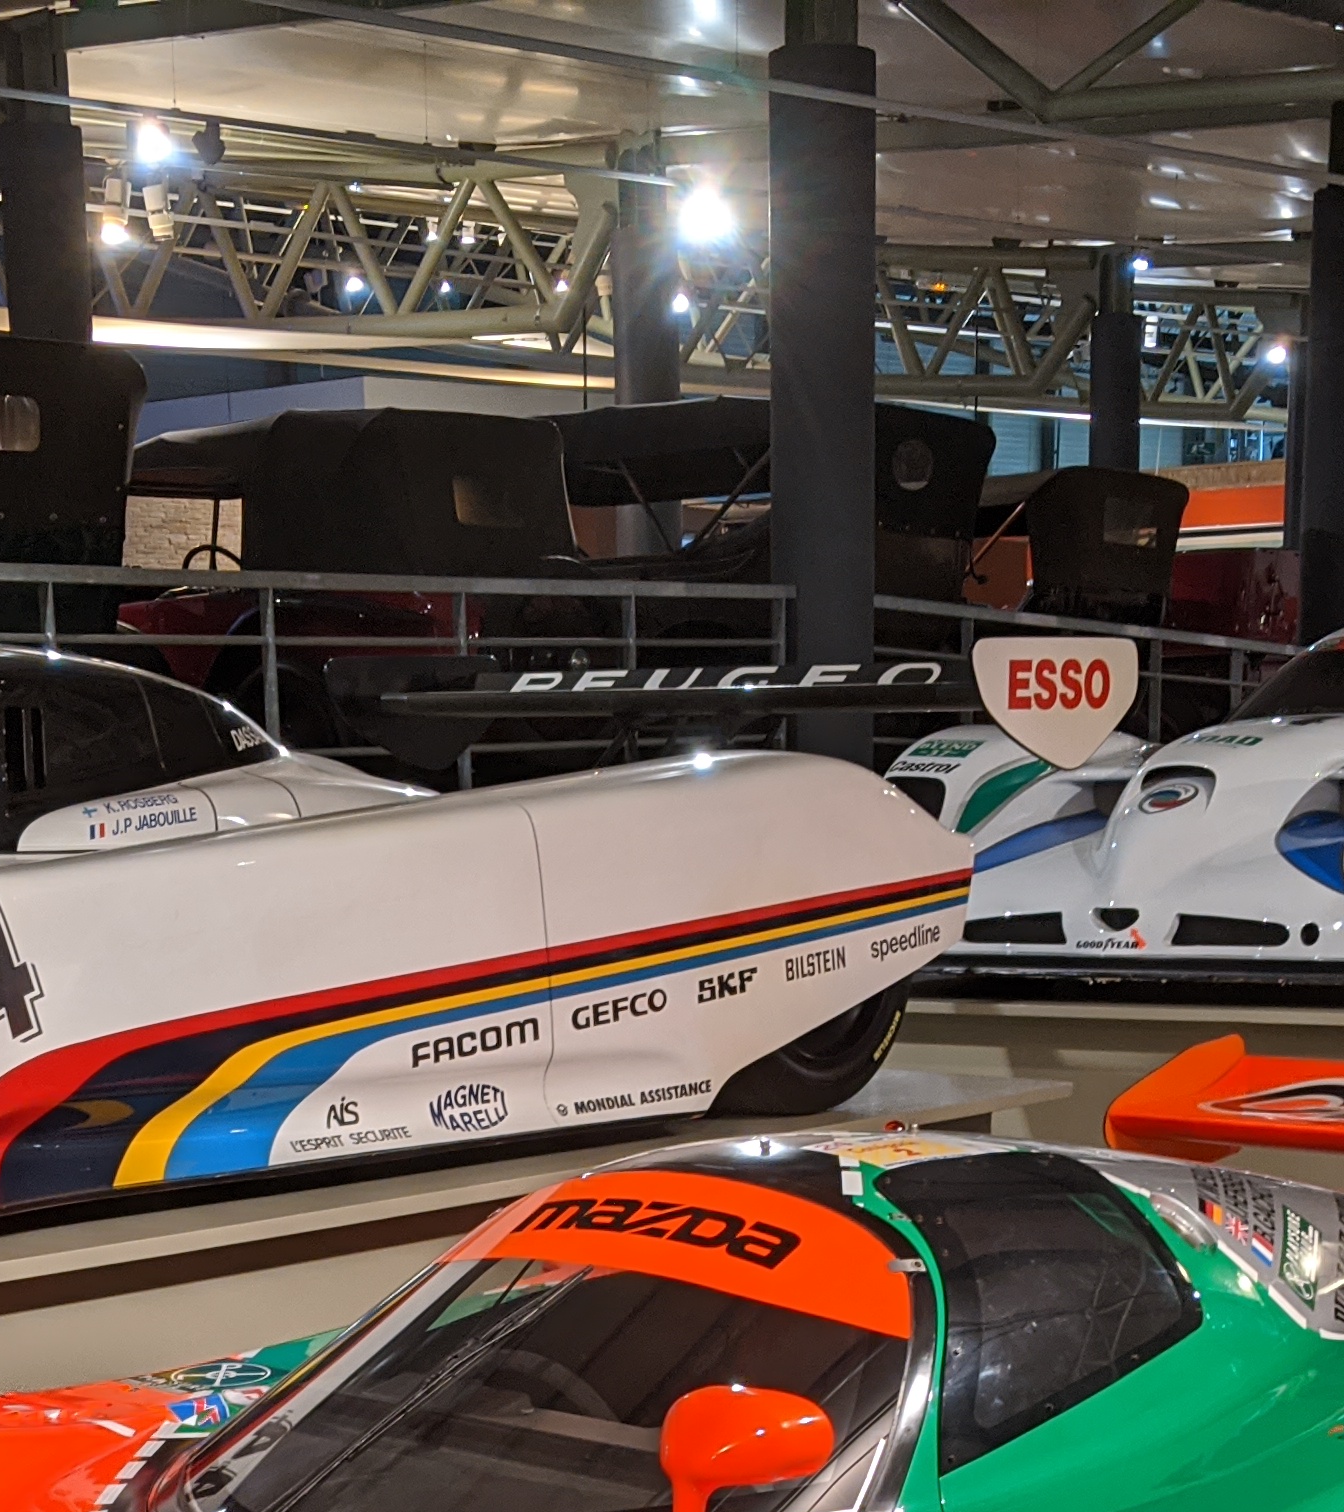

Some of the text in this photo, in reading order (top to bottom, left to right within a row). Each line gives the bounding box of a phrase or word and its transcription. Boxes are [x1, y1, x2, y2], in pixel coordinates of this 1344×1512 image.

[509, 662, 943, 693] PEUGEO
[1008, 658, 1110, 710] ESSO
[889, 760, 961, 774] Castrol
[135, 807, 197, 831] JABOUILLE
[870, 924, 941, 963] speedline
[785, 946, 847, 982] BILSTEIN
[697, 967, 758, 1004] SKF
[572, 988, 667, 1030] GEFCO
[412, 1017, 540, 1069] FACOM
[574, 1079, 712, 1115] MONDIAL ASSISTANCE
[349, 1126, 412, 1146] SECURITE
